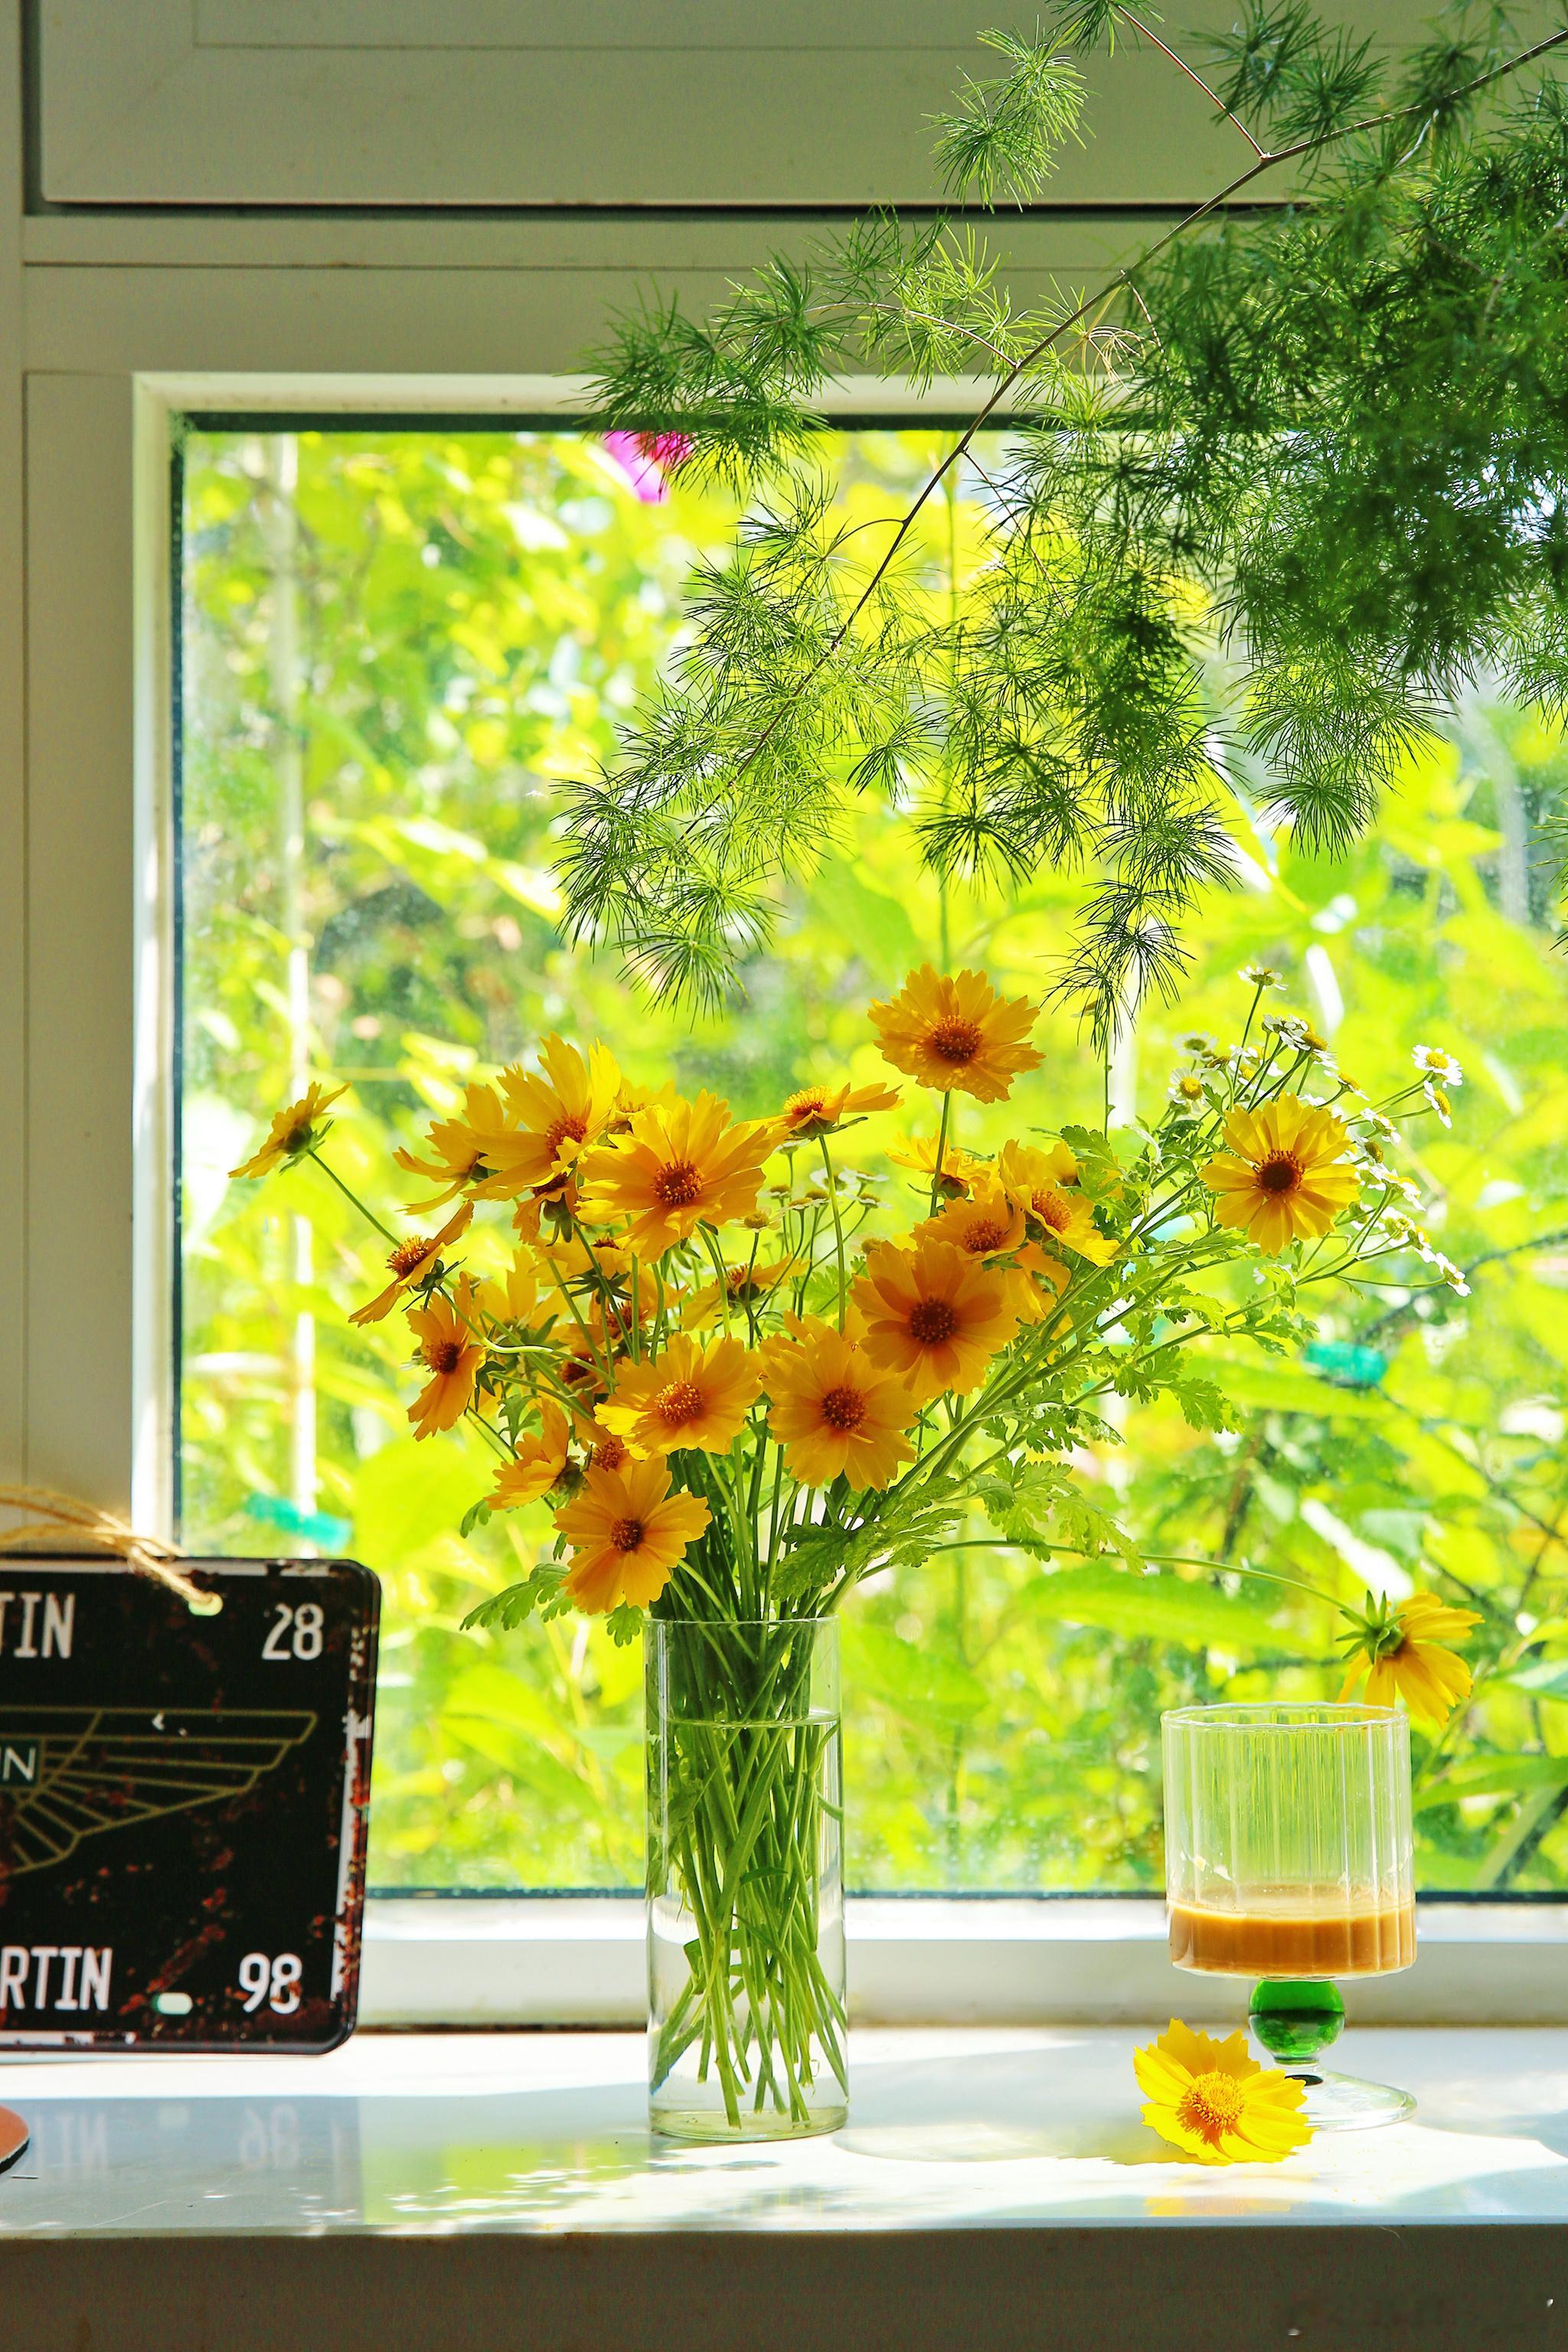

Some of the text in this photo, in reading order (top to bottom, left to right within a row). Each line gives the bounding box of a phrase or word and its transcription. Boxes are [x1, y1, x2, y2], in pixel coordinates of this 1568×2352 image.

[261, 1602, 324, 1661] 28
[0, 1945, 113, 2011] RTIN
[238, 1952, 302, 2014] 98
